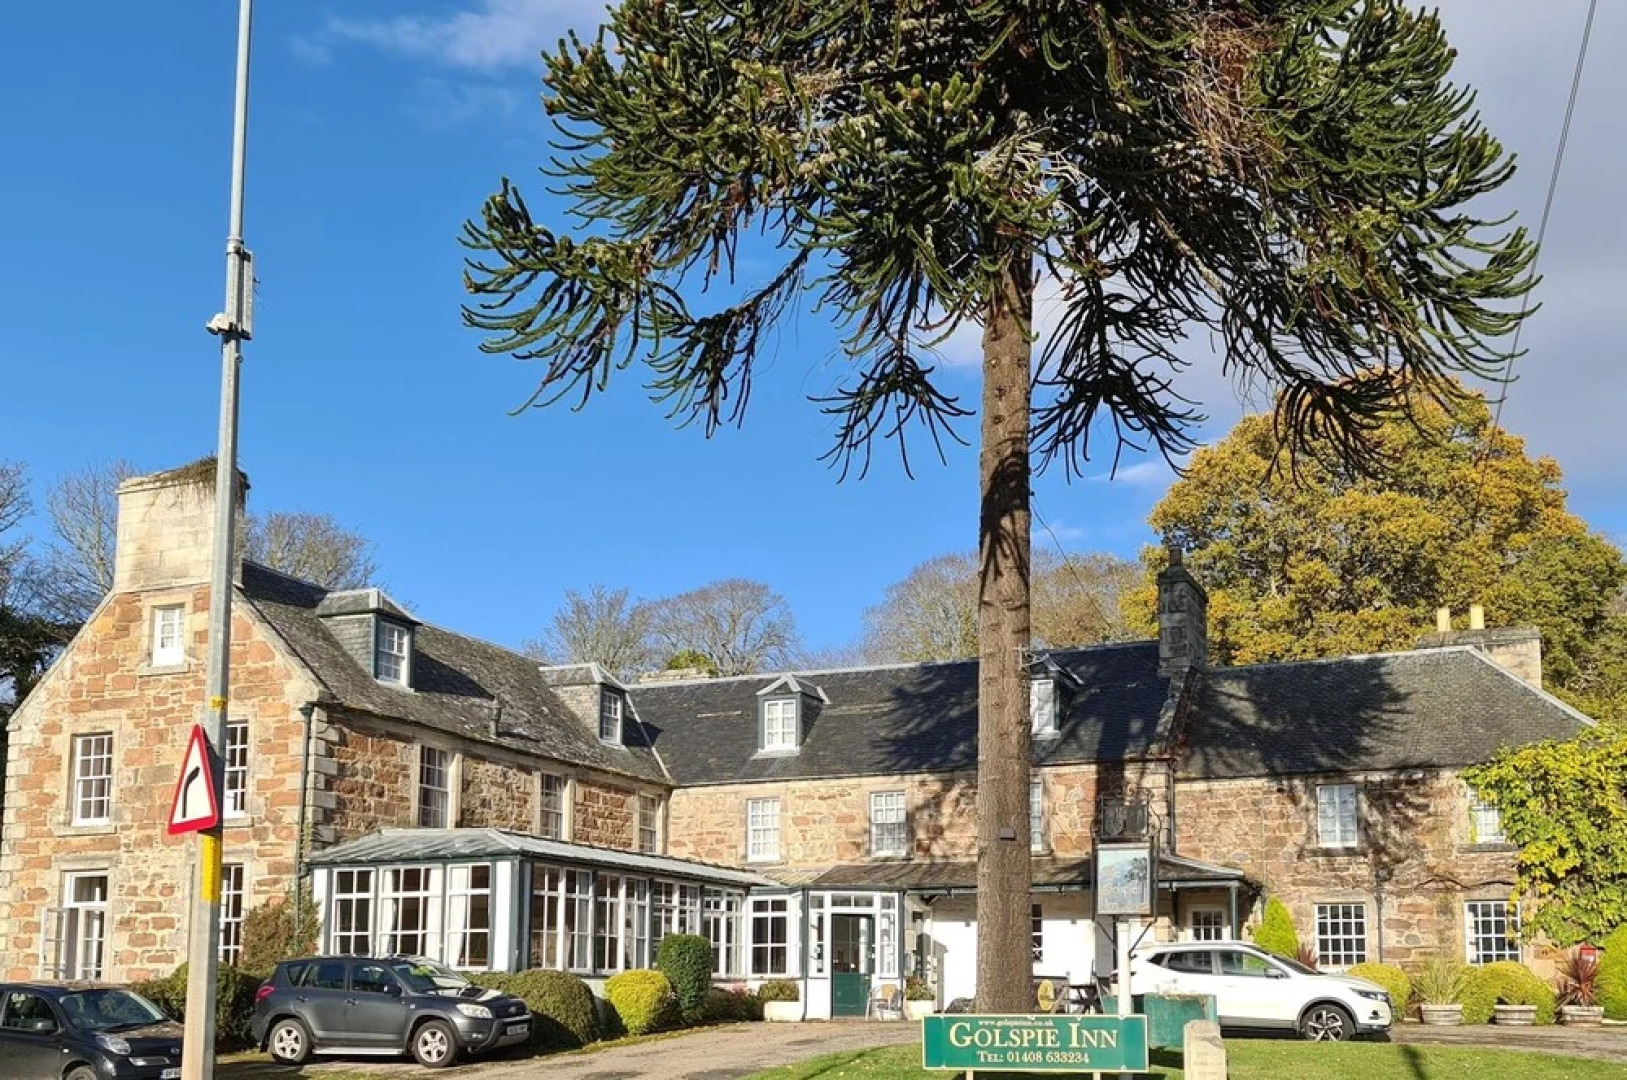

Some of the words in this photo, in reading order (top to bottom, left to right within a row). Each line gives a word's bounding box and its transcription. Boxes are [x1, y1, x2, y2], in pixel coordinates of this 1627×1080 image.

[949, 1022, 1060, 1047] GOLSPIE
[1068, 1022, 1118, 1048] INN
[1006, 1050, 1043, 1063] 01408
[1045, 1051, 1090, 1064] 633234
